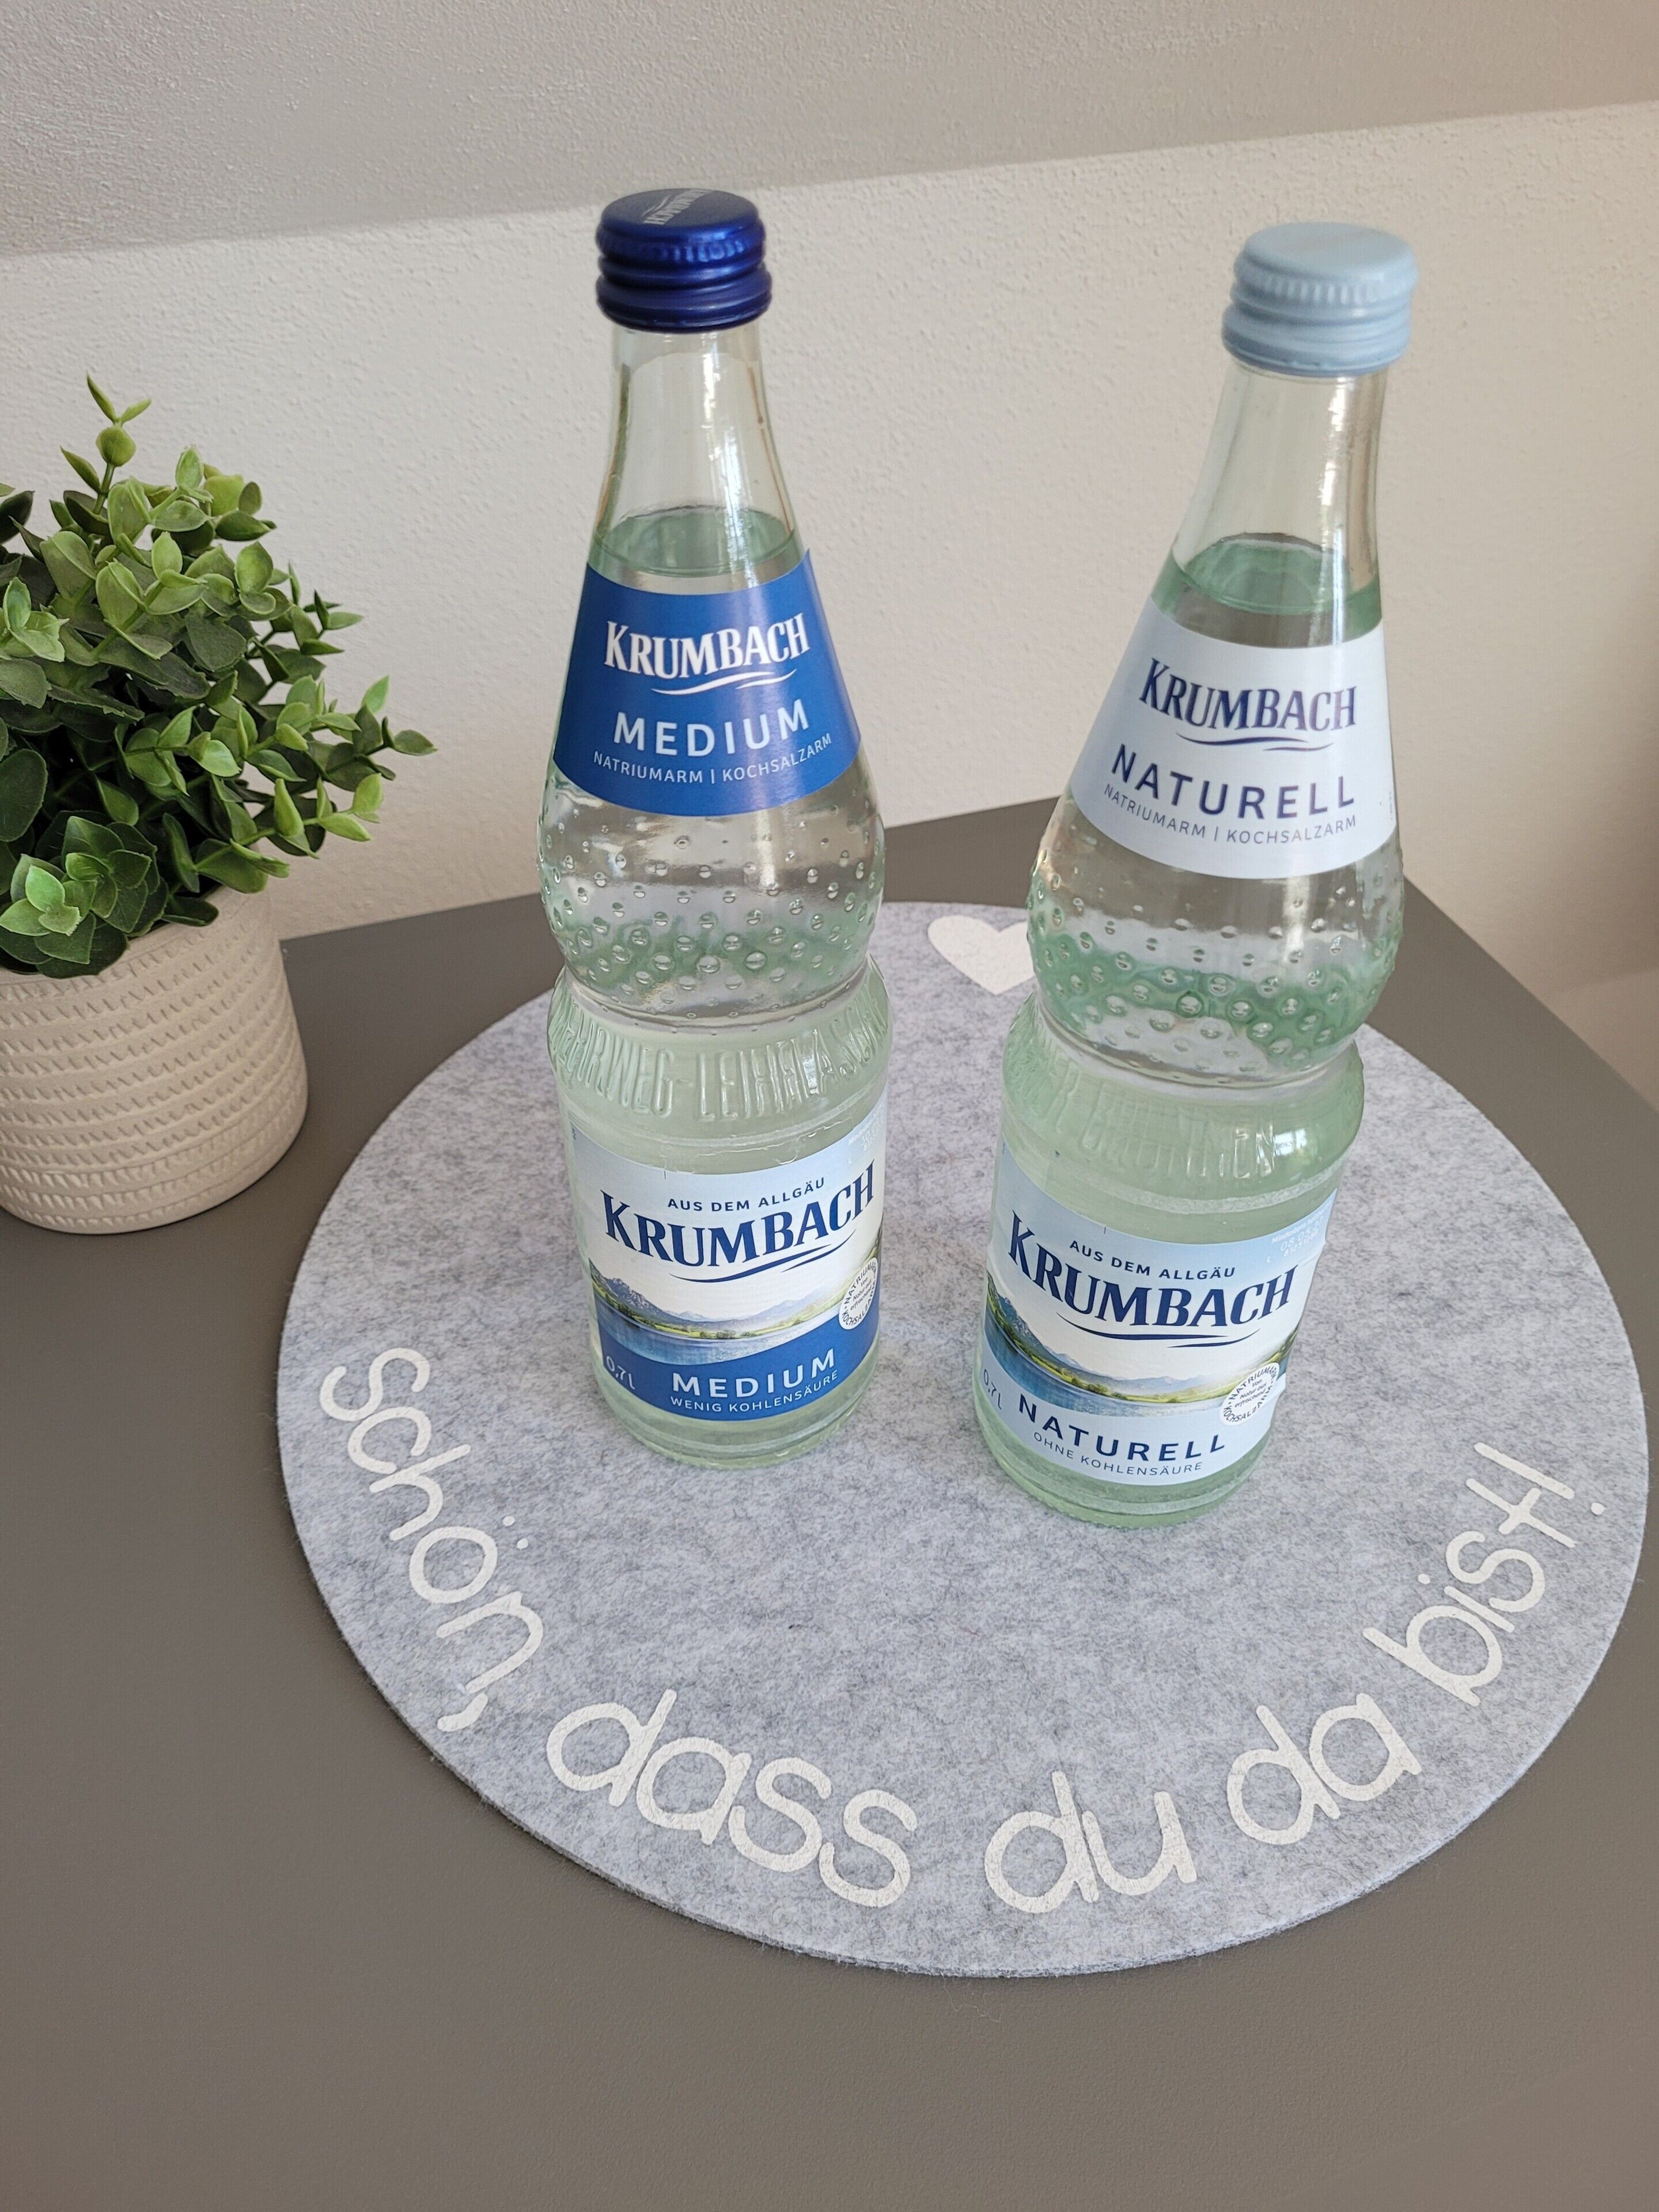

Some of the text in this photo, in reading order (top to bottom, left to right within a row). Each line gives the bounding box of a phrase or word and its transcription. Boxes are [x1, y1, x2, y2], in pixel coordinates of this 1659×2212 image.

[604, 613, 810, 679] KRUMBACH
[1139, 657, 1357, 731] KRUMBACH
[594, 733, 831, 783] NATRIUMARM KOCHSALZARM
[613, 699, 808, 757] MEDIUM
[1111, 744, 1354, 820] NATURELL
[1104, 783, 1356, 843] NATRIUMARM KOCHSALZARM
[600, 1159, 874, 1267] KRUMBACH
[667, 1177, 825, 1212] AUS DEM ALLGÄU
[1008, 1210, 1298, 1327] KRUMBACH
[1070, 1240, 1236, 1281] AUS DEM ALLGÄU
[670, 1369, 838, 1412] WENIG KOHLENSÄURE
[672, 1348, 835, 1398] MEDIUM
[1019, 1393, 1225, 1461] NATURELL
[1034, 1432, 1203, 1476] OHNE KOHLENSÄURE
[546, 1688, 918, 1908] dass
[984, 1770, 1198, 1914] du
[1226, 1692, 1422, 1845] da
[1362, 1441, 1607, 1707] bist!
